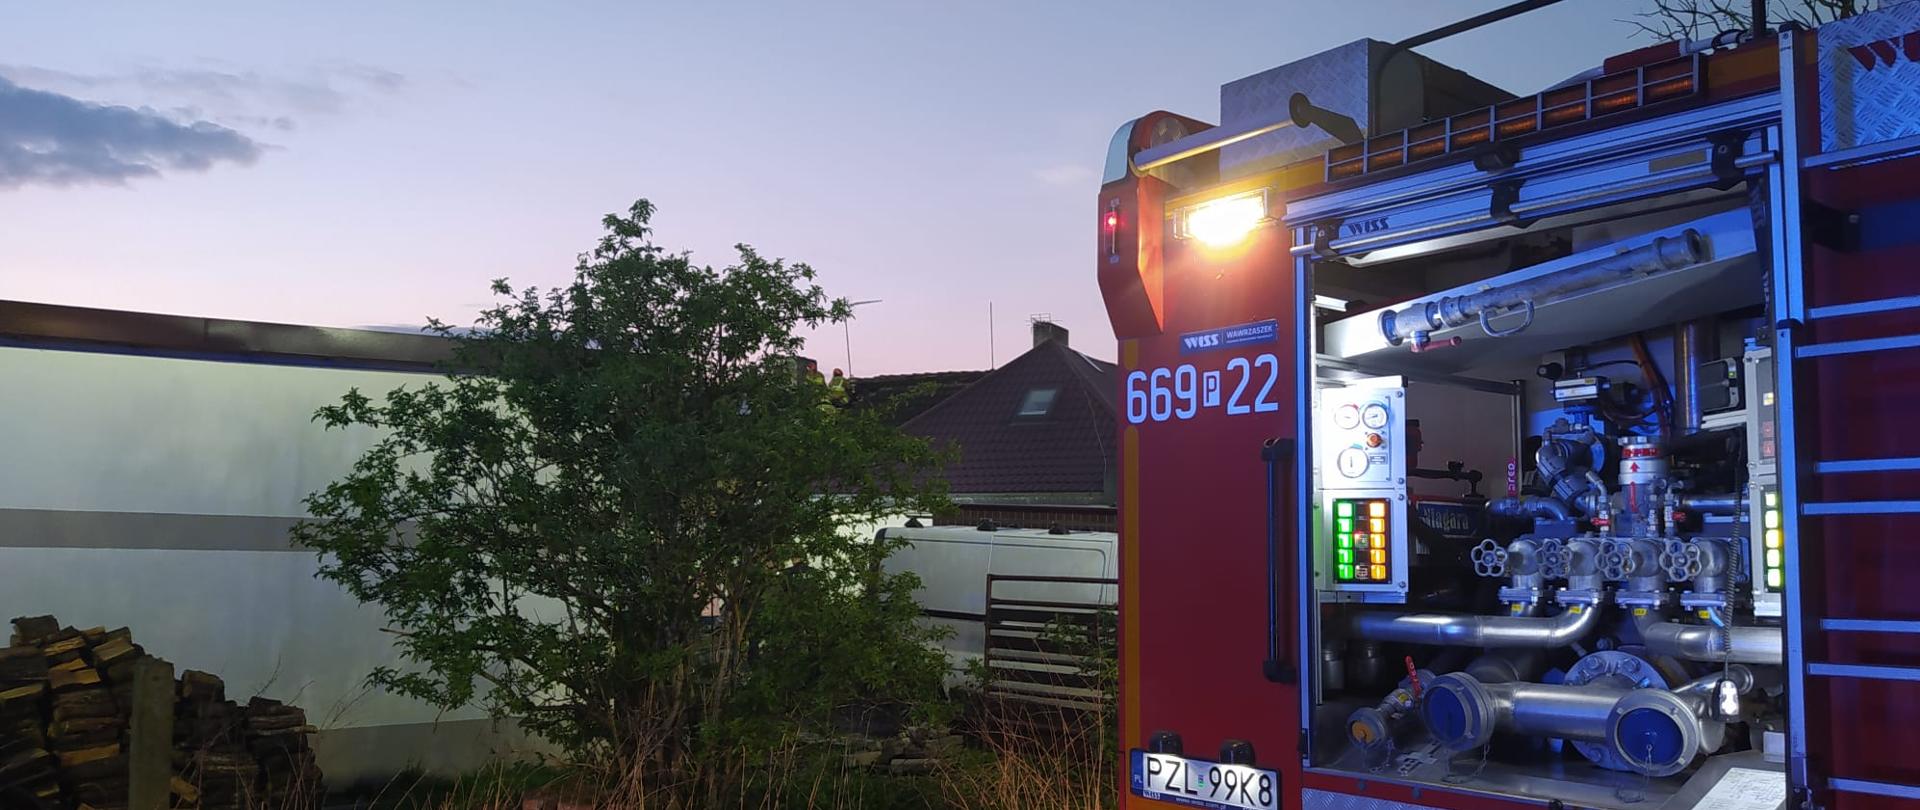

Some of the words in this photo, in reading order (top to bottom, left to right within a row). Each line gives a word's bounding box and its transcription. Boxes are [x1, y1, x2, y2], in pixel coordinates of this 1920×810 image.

[1349, 216, 1389, 235] WISS
[1184, 333, 1219, 349] WISS
[1226, 325, 1273, 339] WAWRZASZEK
[1127, 364, 1197, 424] 669
[1226, 353, 1279, 415] 22
[1421, 508, 1469, 532] Niagara
[1134, 774, 1143, 784] PL
[1146, 756, 1198, 796] PZL
[1209, 766, 1273, 807] 99K8
